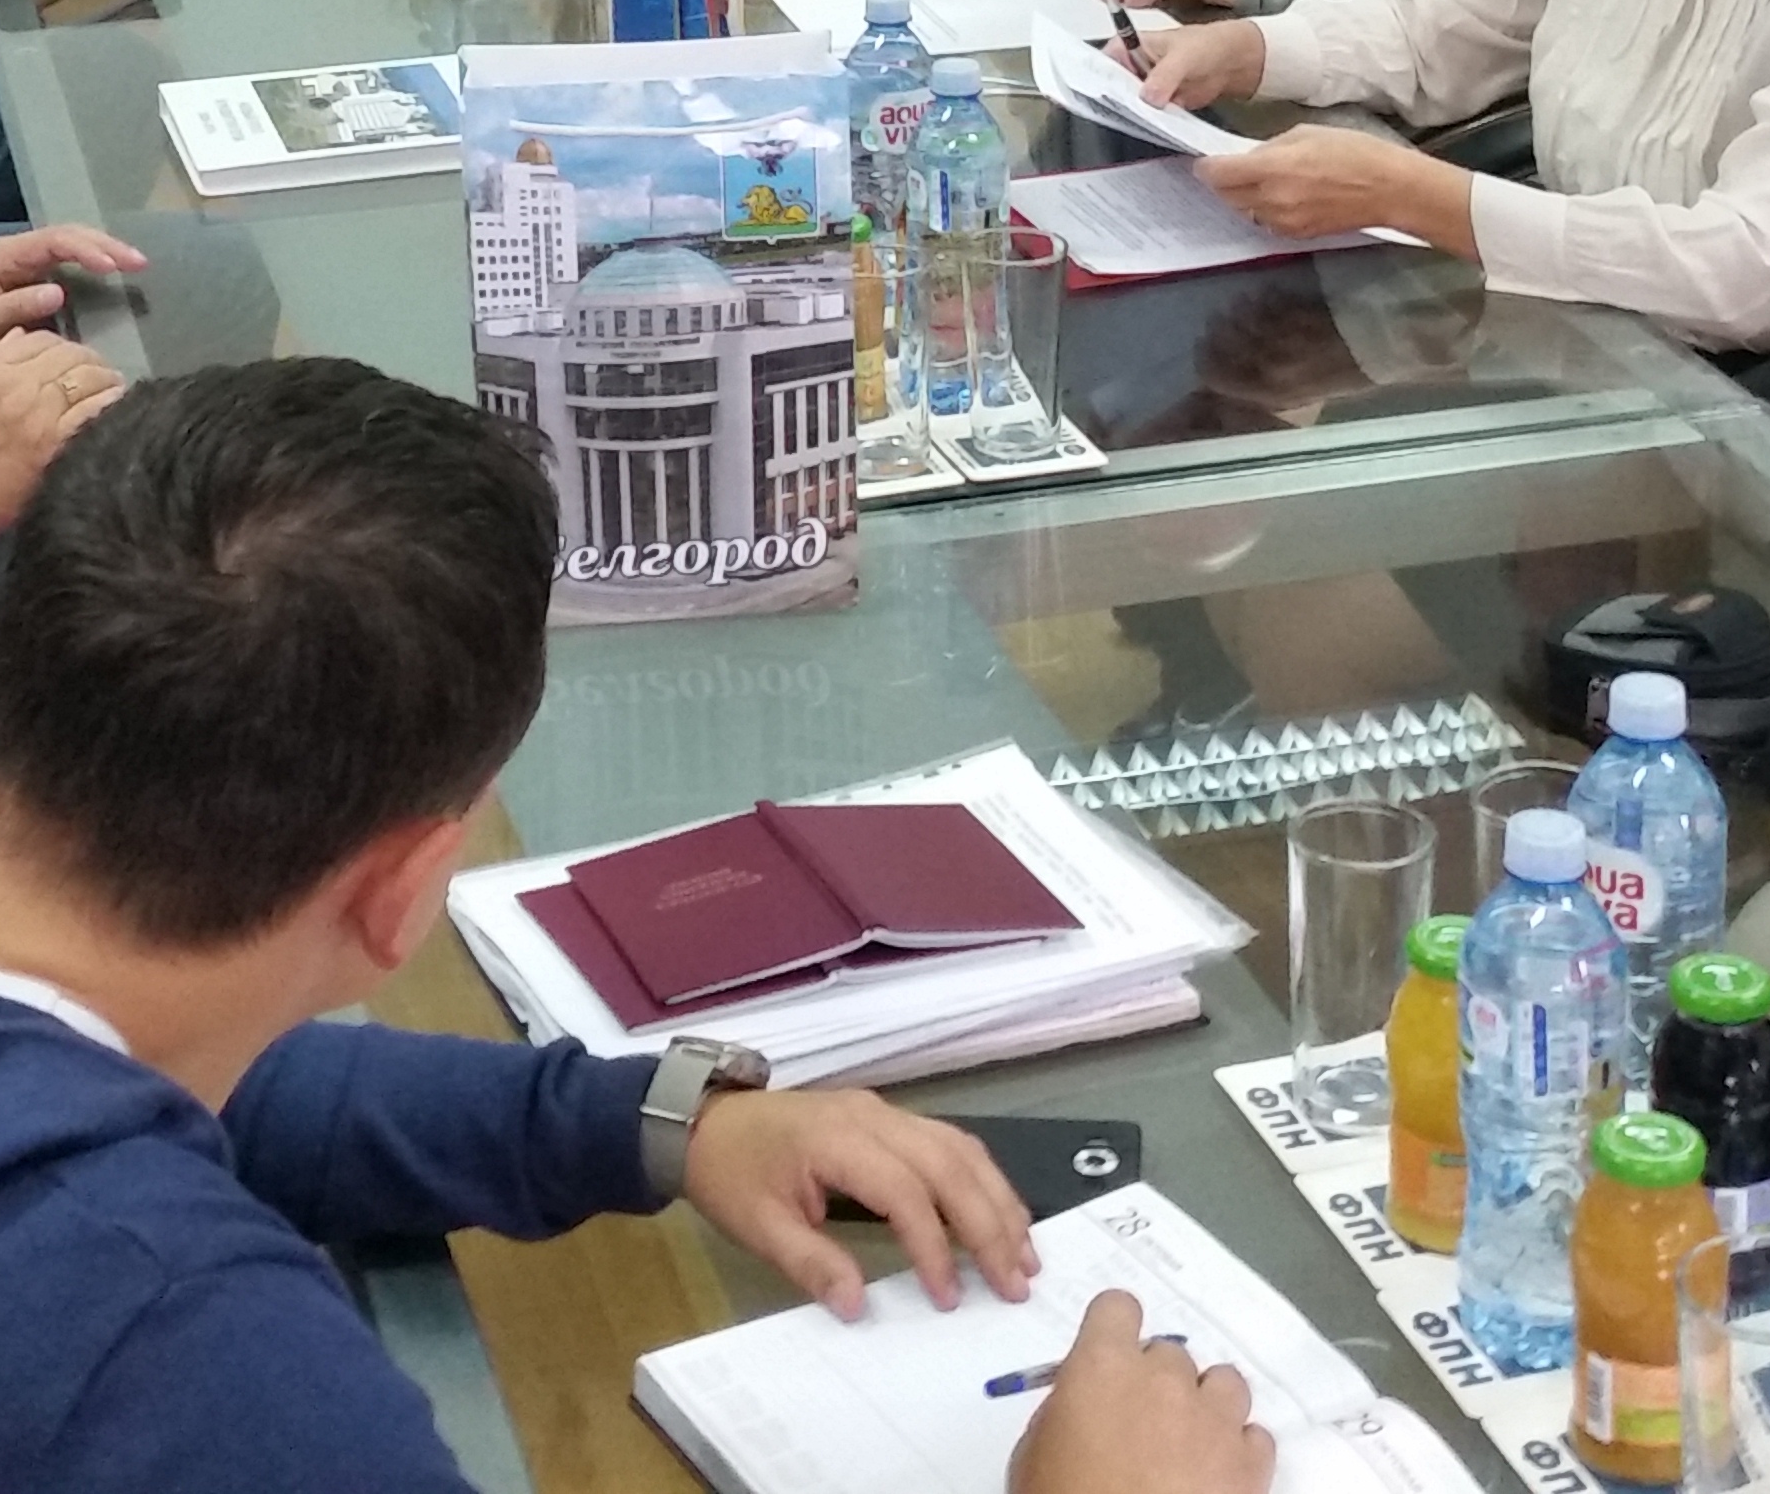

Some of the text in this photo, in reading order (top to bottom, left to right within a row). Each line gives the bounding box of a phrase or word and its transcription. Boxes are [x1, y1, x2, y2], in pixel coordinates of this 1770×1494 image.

[1582, 861, 1644, 899] ua
[1246, 1087, 1316, 1149] ФПН
[1103, 1205, 1151, 1237] 28
[1329, 1193, 1404, 1262] ФПН
[1413, 1311, 1493, 1388] ФПН
[1521, 1440, 1588, 1494] ФП
